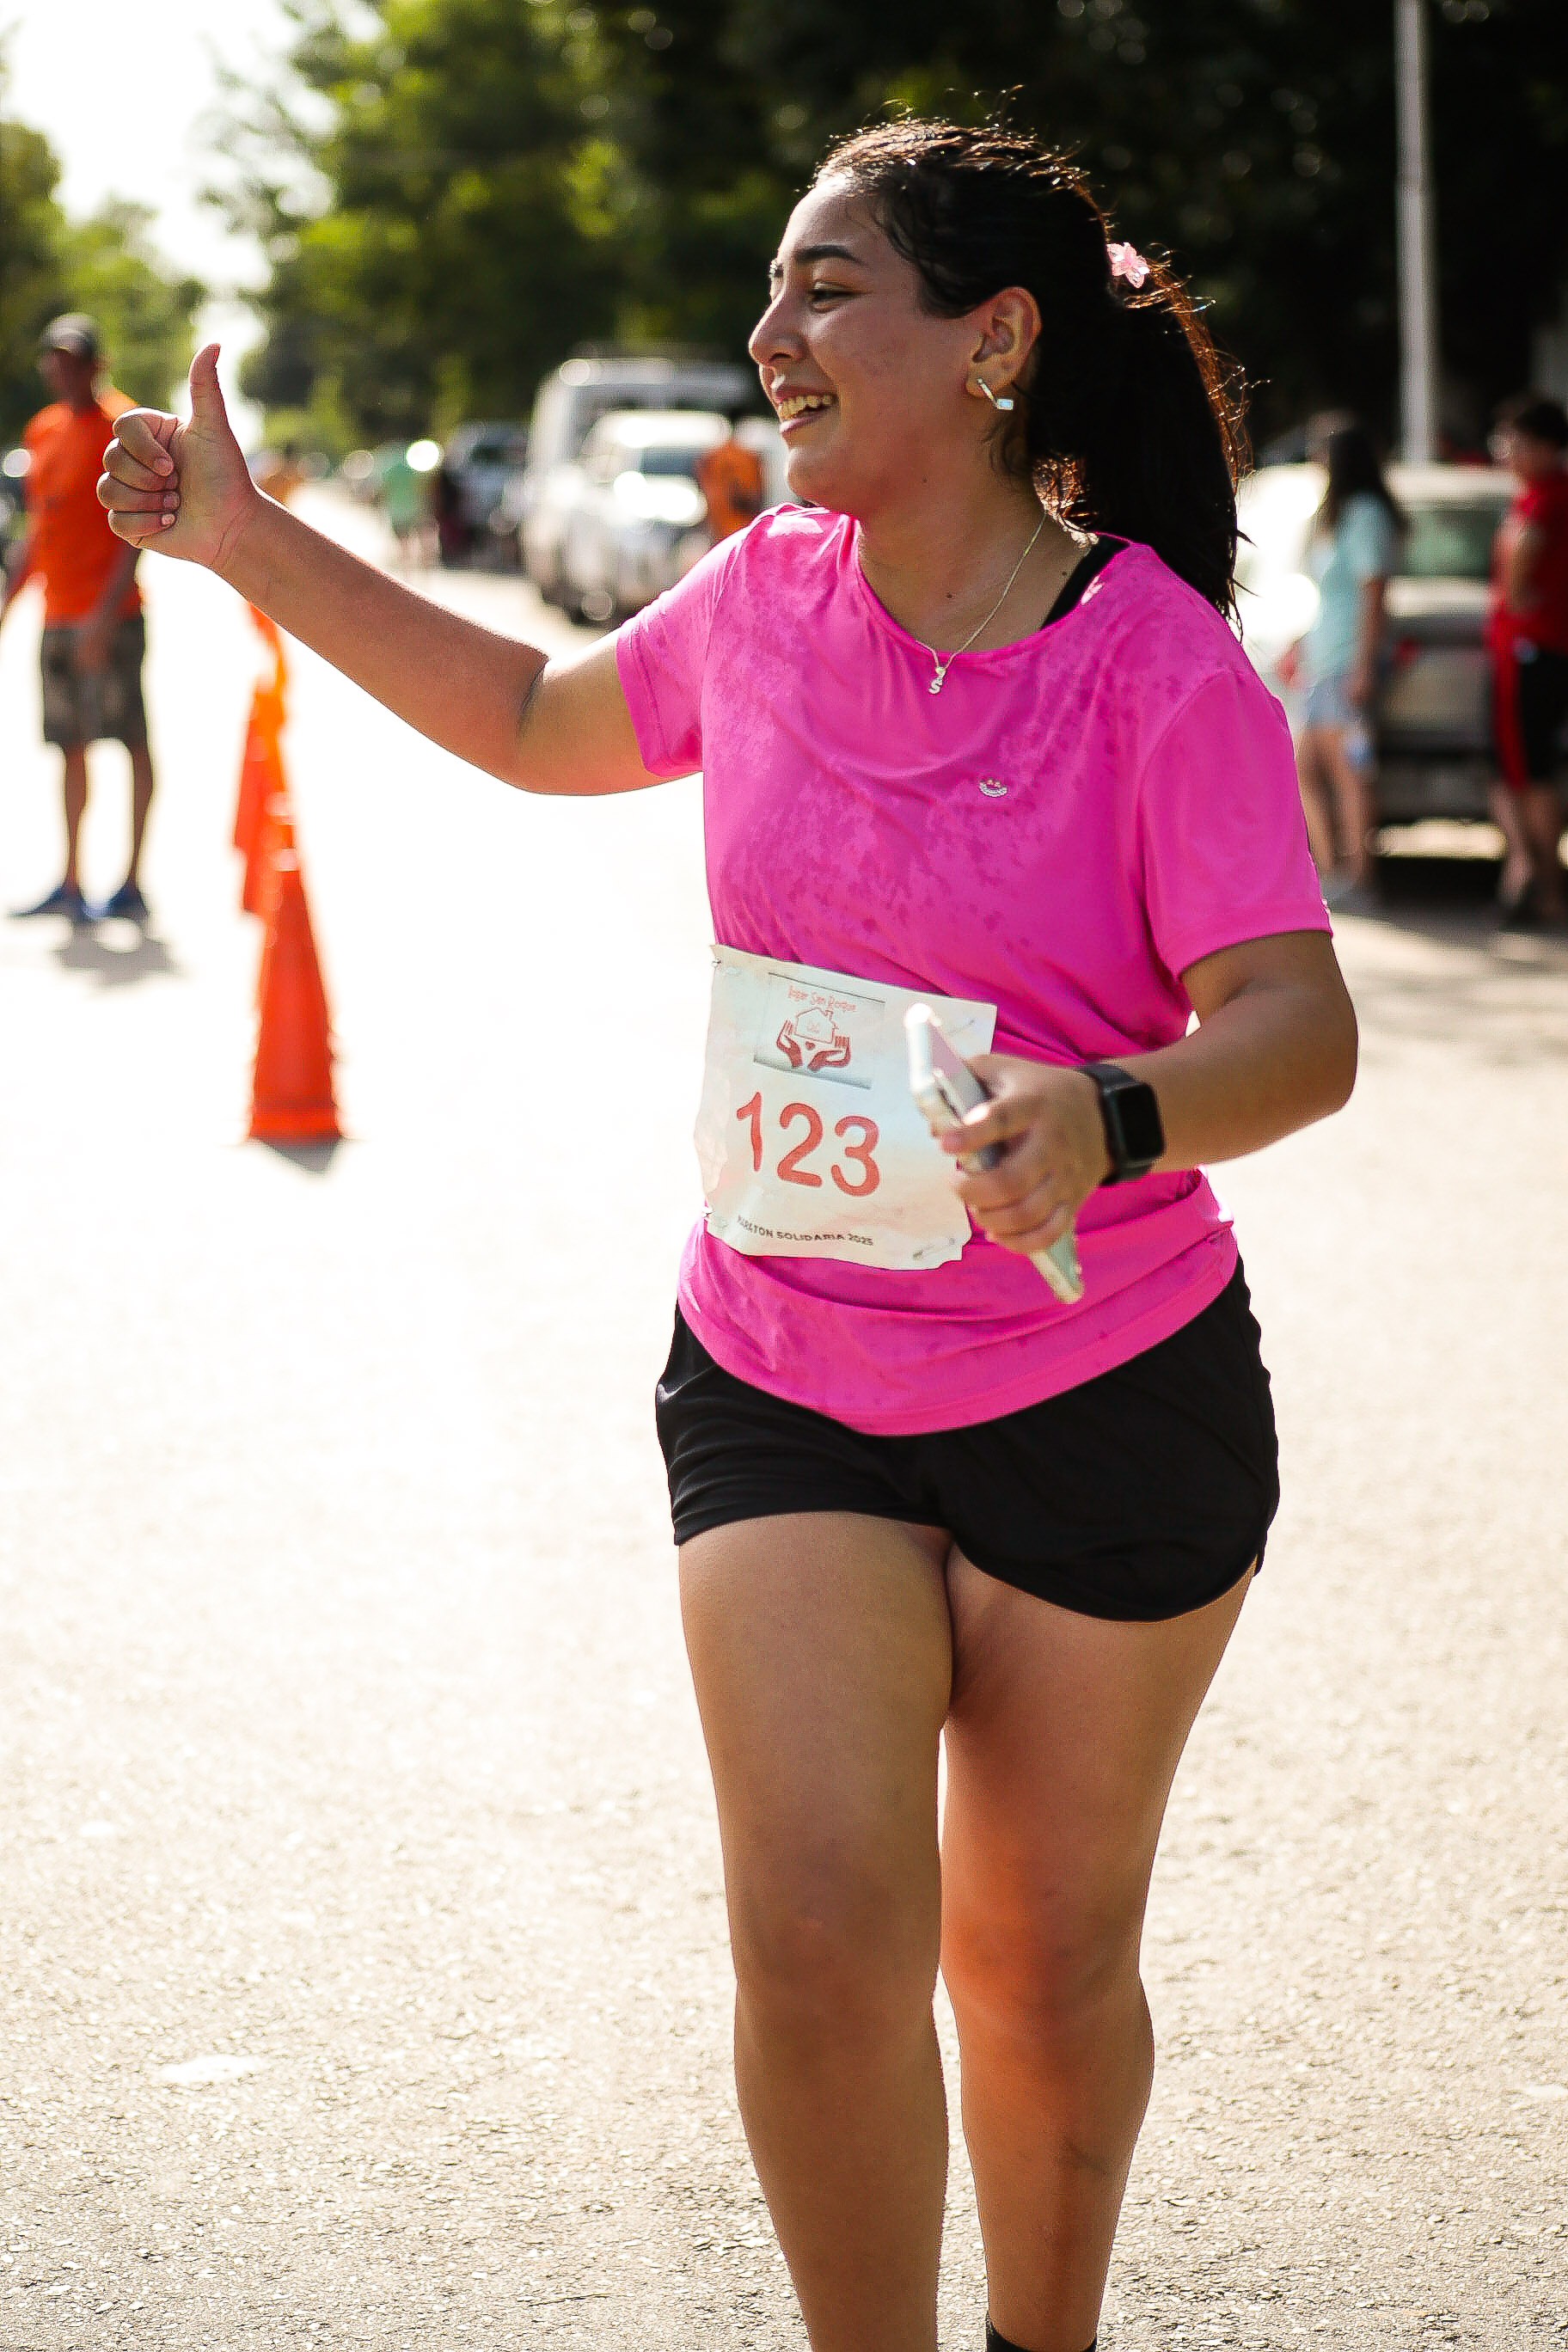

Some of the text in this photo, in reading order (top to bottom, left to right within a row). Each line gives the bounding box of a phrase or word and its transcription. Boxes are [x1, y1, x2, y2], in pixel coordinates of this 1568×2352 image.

[737, 1091, 880, 1197] 123
[776, 1231, 846, 1241] SOLIDARIA
[848, 1234, 873, 1246] 2025
